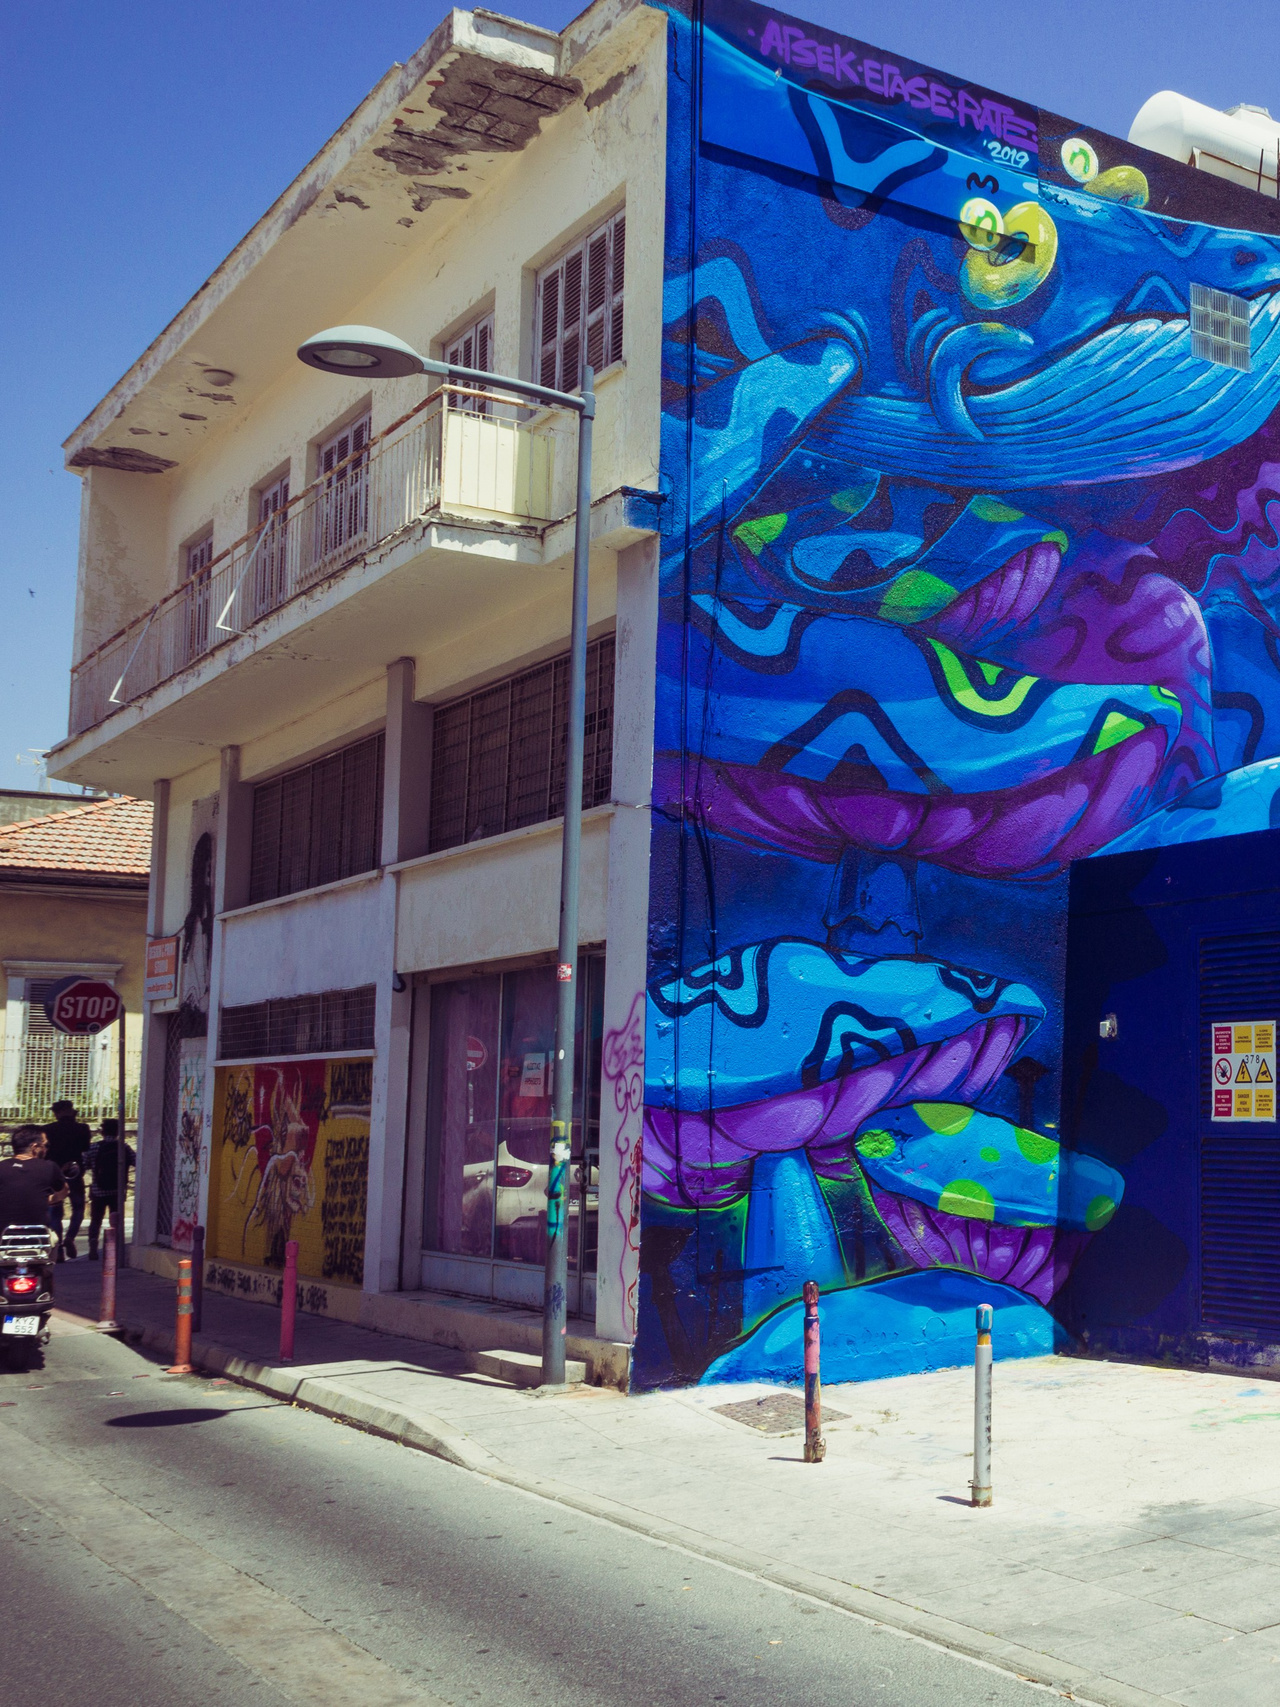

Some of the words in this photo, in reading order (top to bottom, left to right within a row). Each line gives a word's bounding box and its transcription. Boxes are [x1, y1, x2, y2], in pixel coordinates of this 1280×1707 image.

[60, 996, 116, 1019] STOP
[1244, 1054, 1260, 1064] 378
[14, 1325, 33, 1334] 552
